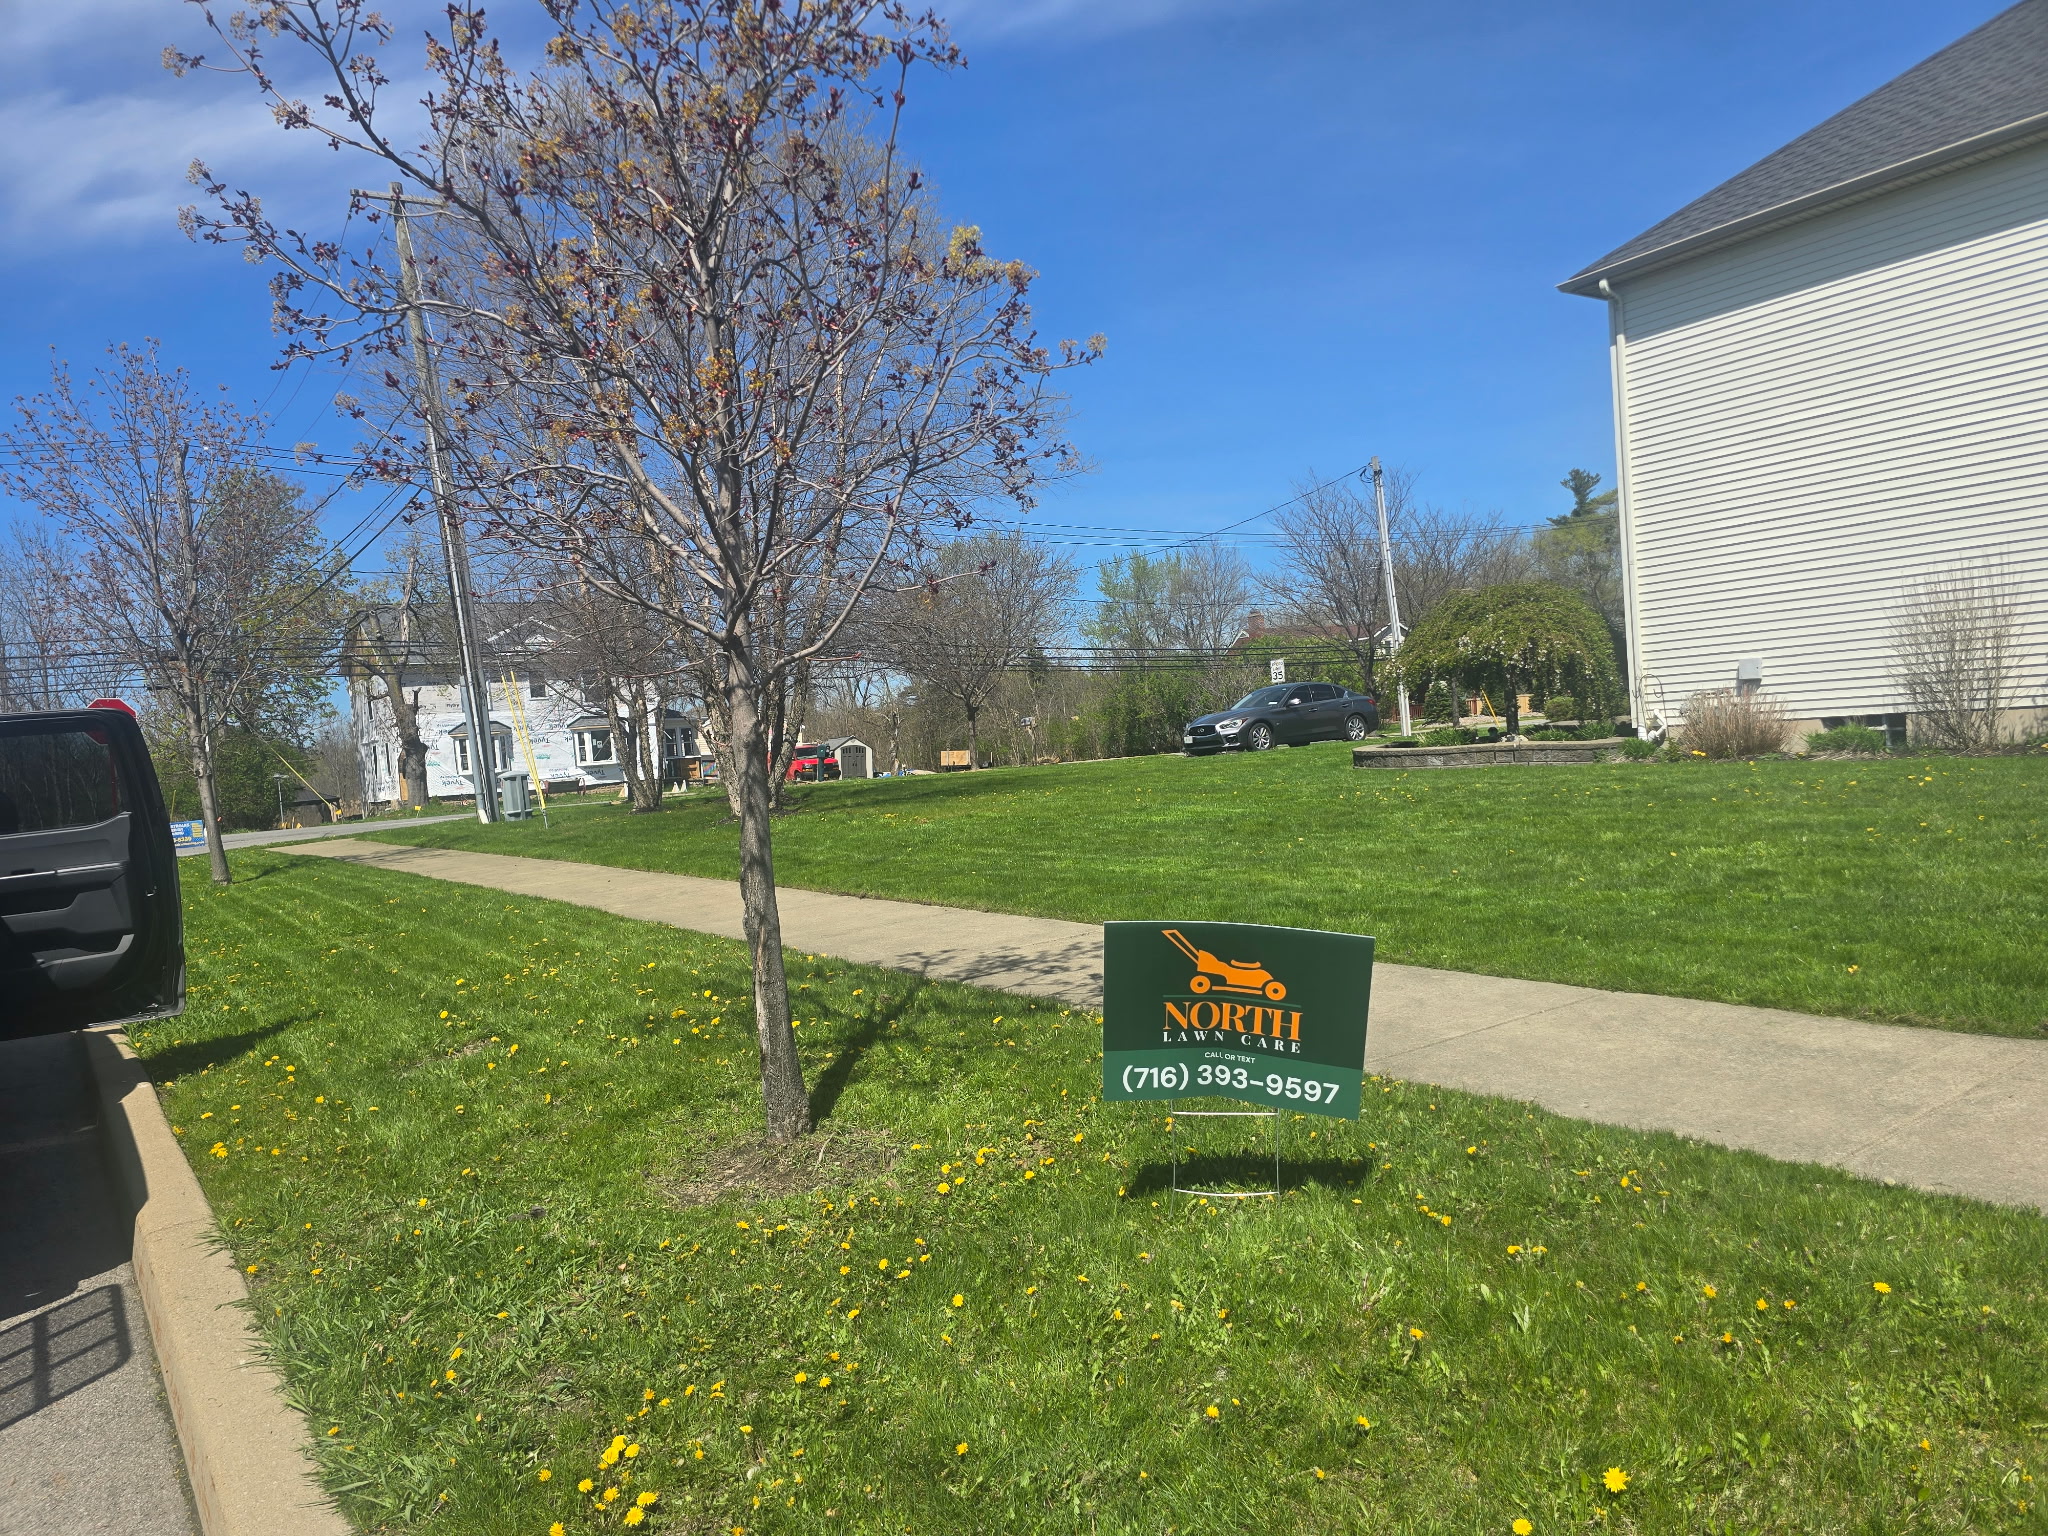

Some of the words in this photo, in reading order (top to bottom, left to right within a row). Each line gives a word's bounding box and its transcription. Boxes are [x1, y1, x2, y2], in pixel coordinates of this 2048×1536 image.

[1272, 670, 1284, 681] 35
[442, 779, 464, 787] Tyvek
[1163, 1001, 1303, 1041] NORTH
[1163, 1030, 1225, 1042] LAWN
[1240, 1034, 1301, 1054] CARE
[1224, 1053, 1236, 1061] OR
[1237, 1054, 1256, 1064] TEXT
[1122, 1063, 1189, 1093] (716)
[1196, 1064, 1339, 1104] 393-9597
